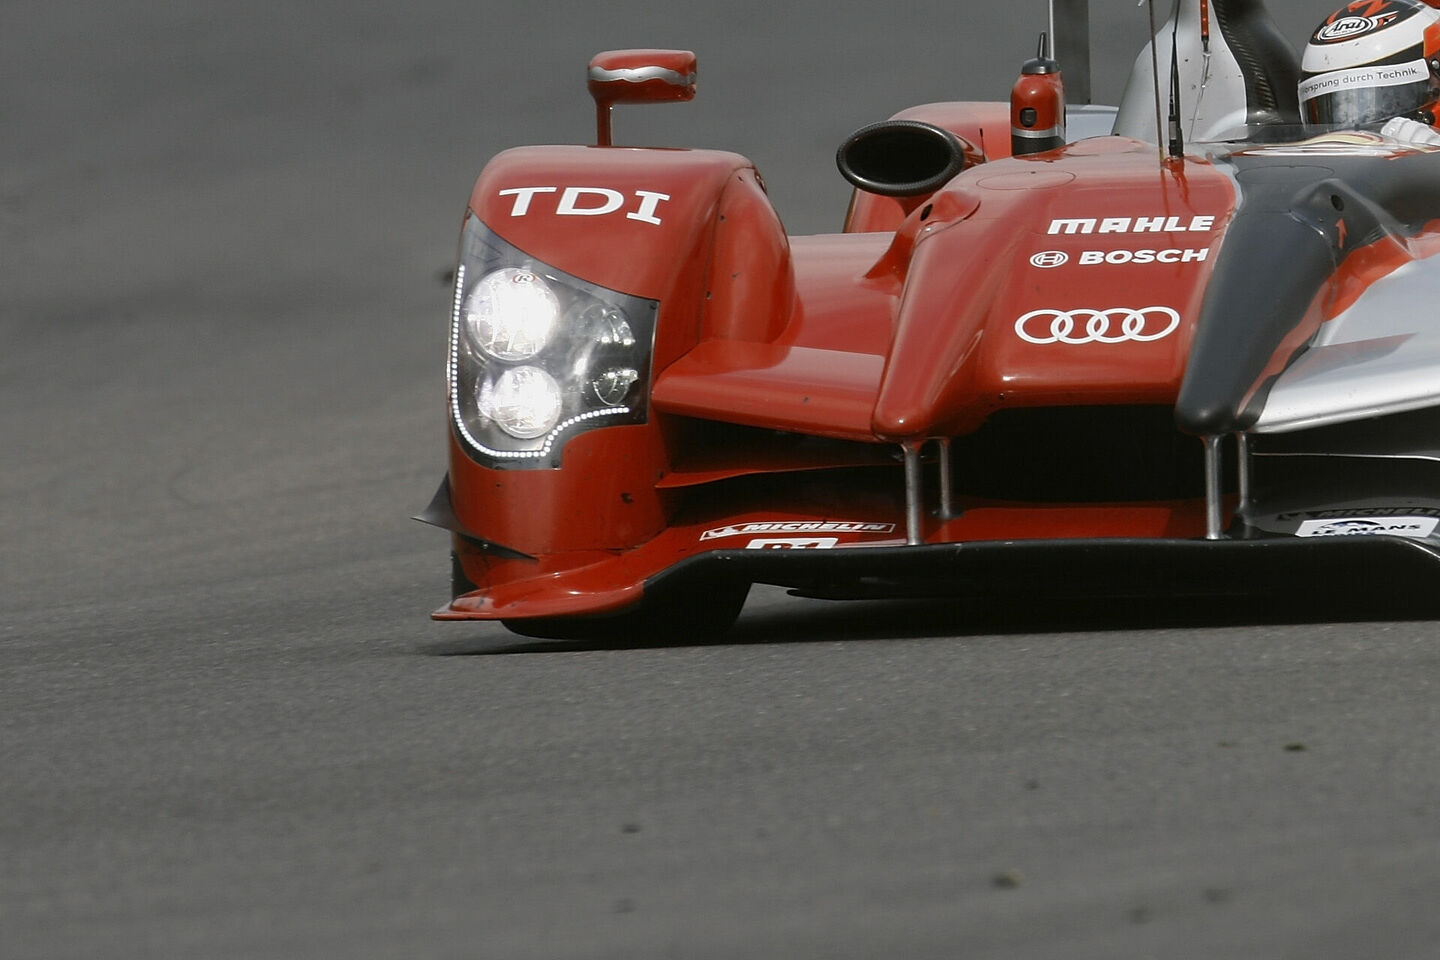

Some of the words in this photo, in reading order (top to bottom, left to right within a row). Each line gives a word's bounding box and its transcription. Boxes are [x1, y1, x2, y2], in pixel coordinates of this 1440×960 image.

[1302, 79, 1339, 94] orsprung
[1342, 73, 1374, 84] durch
[1376, 67, 1418, 80] Technik
[499, 186, 670, 225] TDI
[1047, 215, 1215, 234] MAHLE
[1078, 247, 1209, 265] BOSCH
[742, 523, 885, 532] MICHELIN
[1350, 524, 1421, 532] MANS
